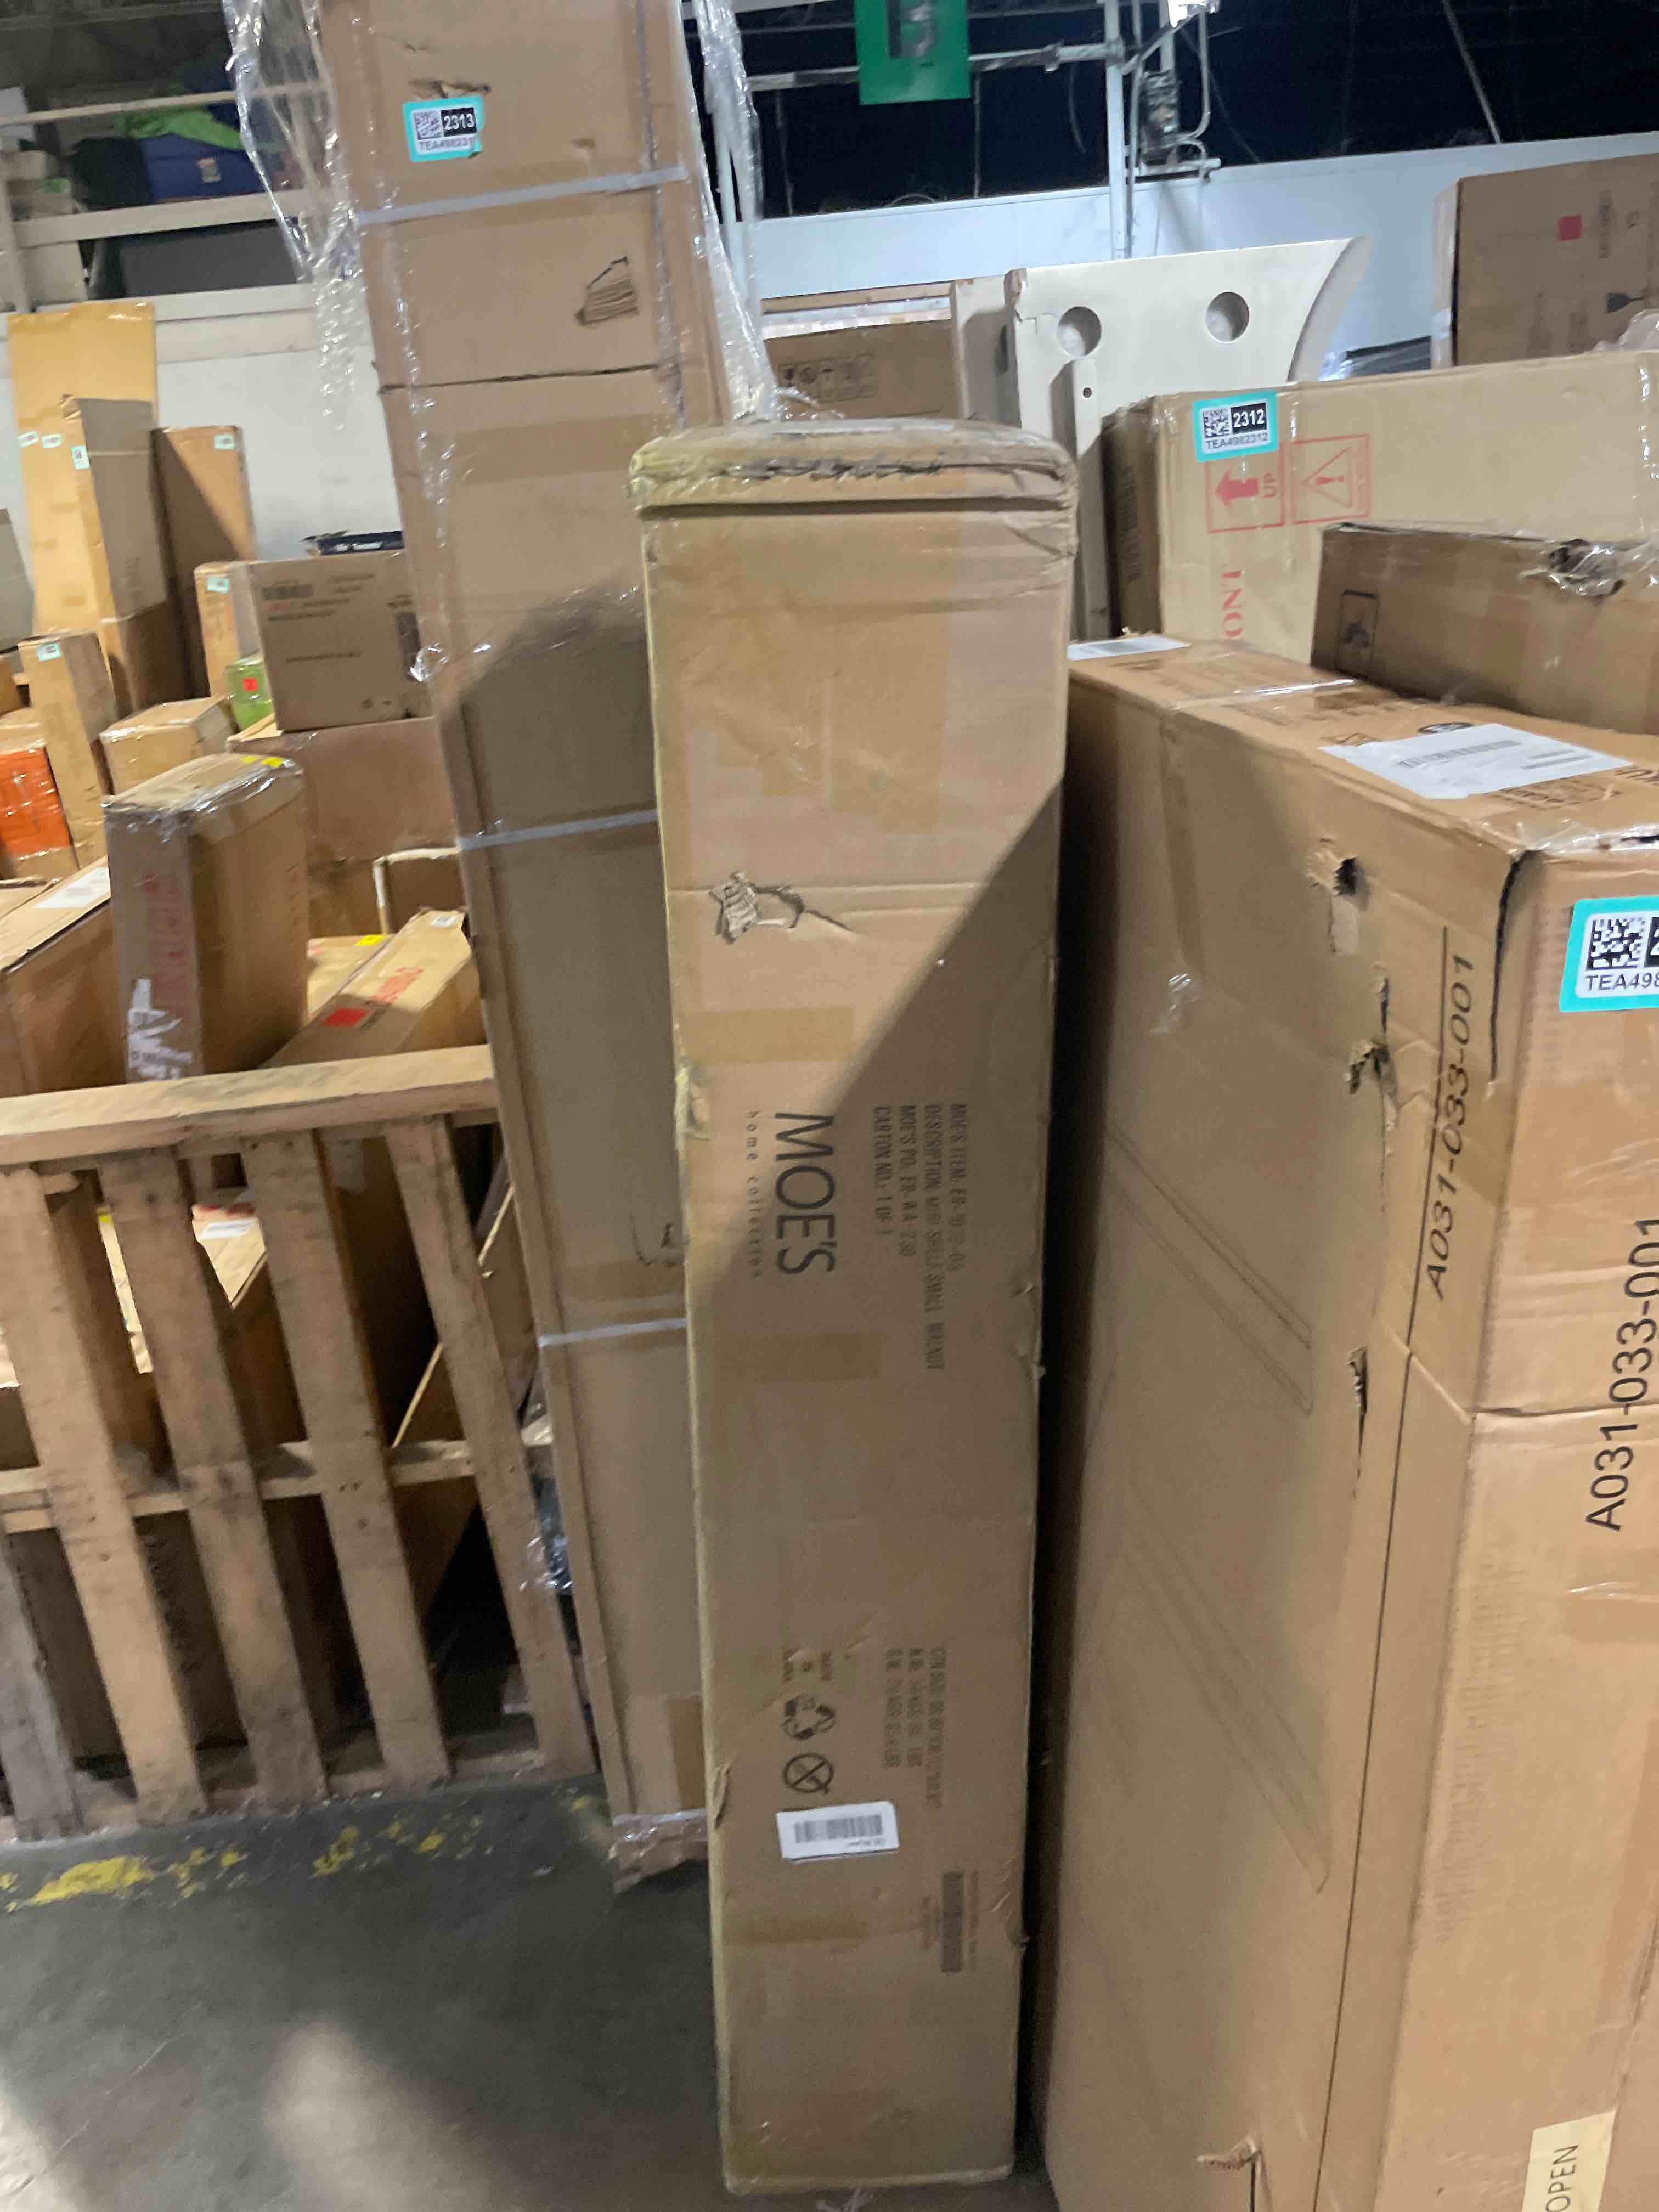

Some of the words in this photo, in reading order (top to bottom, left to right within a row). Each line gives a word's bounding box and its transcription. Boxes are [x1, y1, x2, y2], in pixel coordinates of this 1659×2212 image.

[443, 114, 475, 131] 2313
[1205, 432, 1269, 450] TEA4982312
[1233, 409, 1265, 428] 2312
[747, 1110, 761, 1160] home
[1426, 954, 1475, 1301] A031-033-001
[774, 1111, 837, 1276] MOE'S
[1585, 1218, 1659, 1531] A031-033-001
[1545, 2145, 1579, 2212] OPEN
